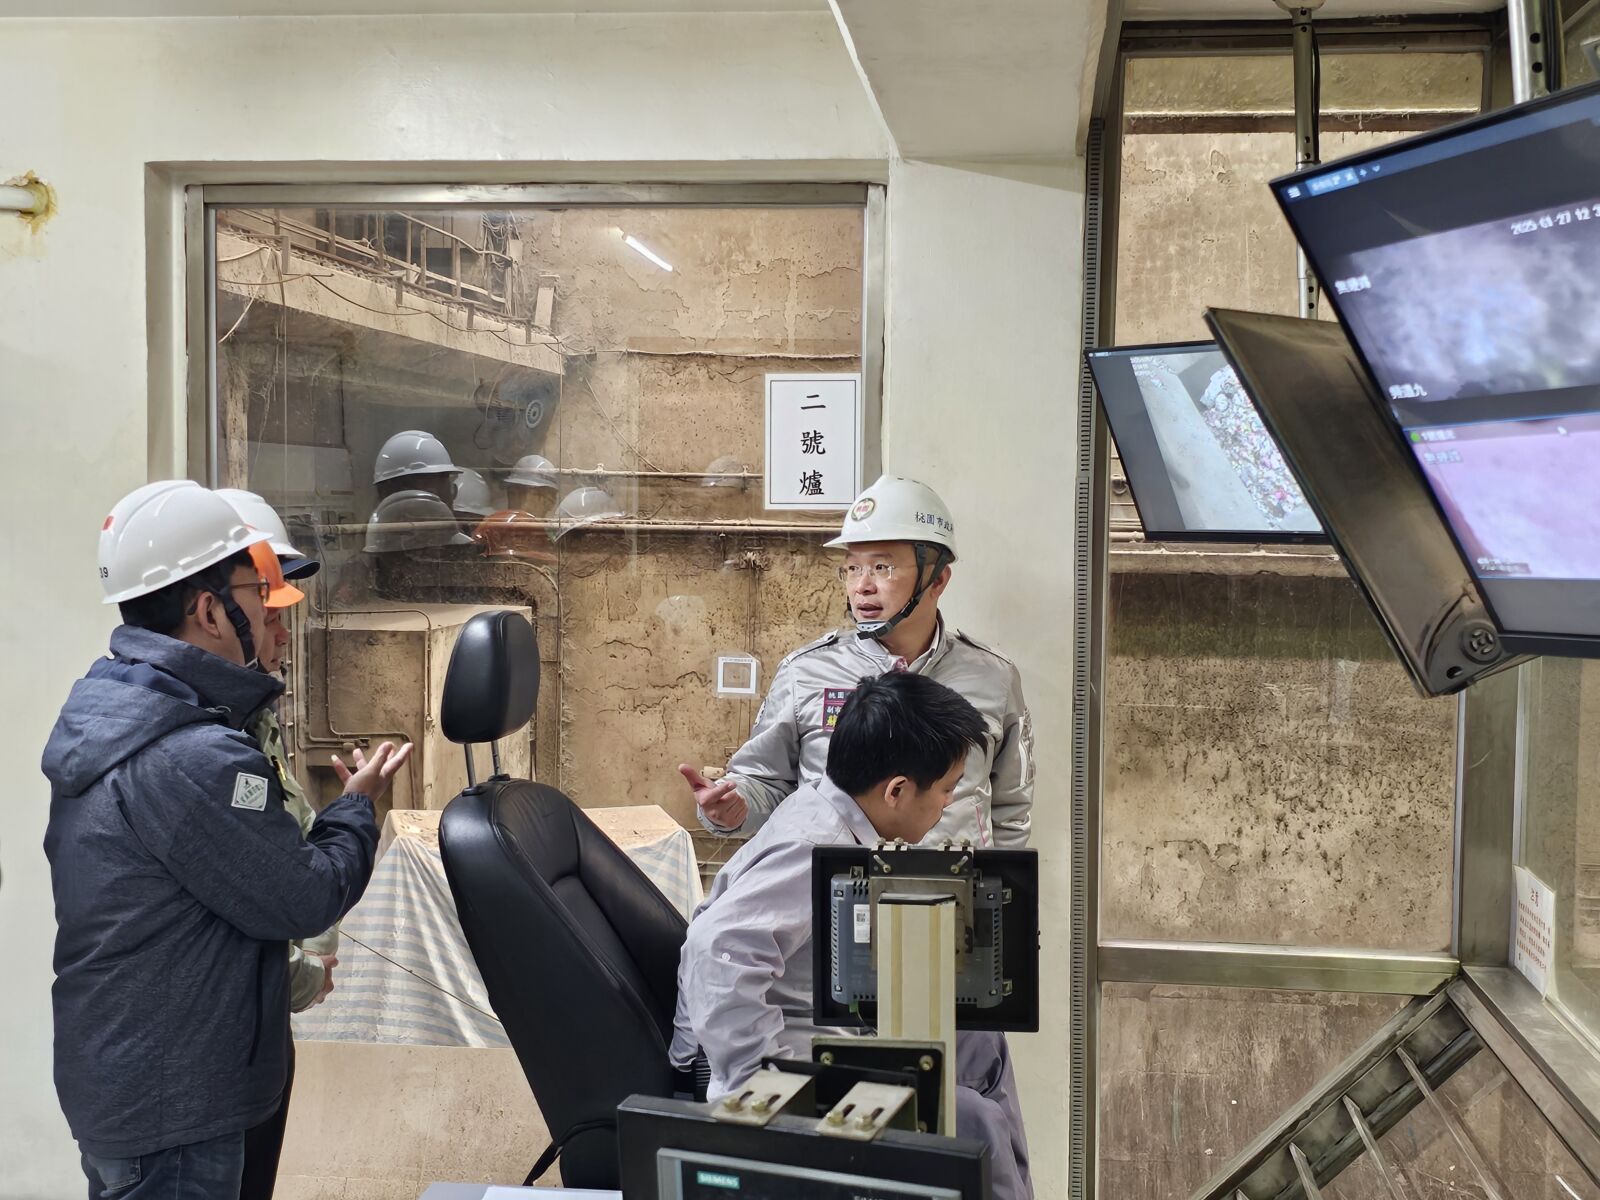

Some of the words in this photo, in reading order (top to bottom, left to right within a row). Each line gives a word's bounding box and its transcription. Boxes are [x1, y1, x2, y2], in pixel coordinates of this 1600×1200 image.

[799, 394, 826, 496] 二號爐
[828, 690, 851, 699] 桃園
[700, 1173, 739, 1187] SIEMENS
